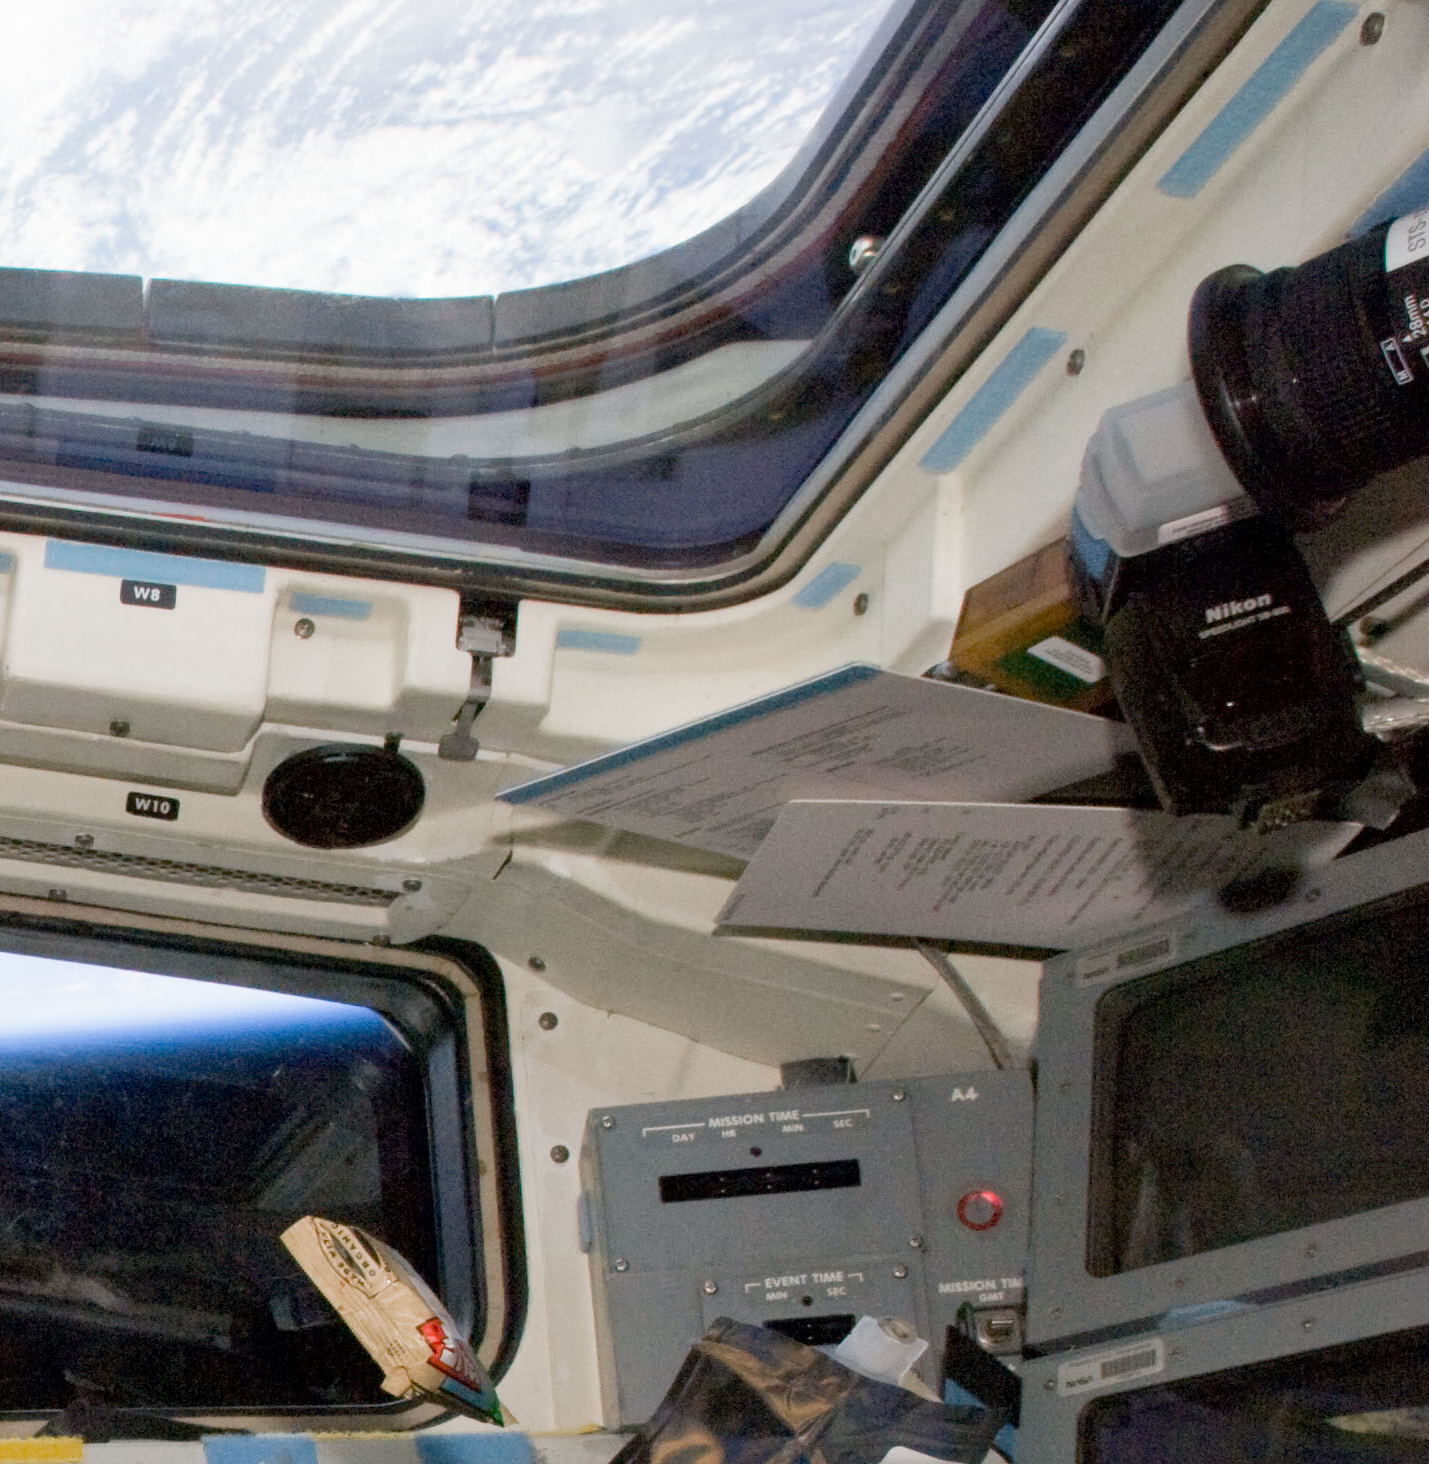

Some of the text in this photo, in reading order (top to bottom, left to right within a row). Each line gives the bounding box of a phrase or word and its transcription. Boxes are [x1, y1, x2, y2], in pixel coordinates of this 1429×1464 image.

[1405, 294, 1427, 339] 28mm
[133, 585, 160, 602] W8
[1205, 593, 1272, 624] Nikon
[134, 796, 171, 817] W10
[952, 1088, 978, 1102] A4
[708, 1110, 801, 1128] MISSION TIME
[833, 1118, 853, 1128] SEC
[782, 1123, 805, 1133] MIN
[672, 1132, 695, 1143] DAY
[330, 1222, 377, 1278] ORGANIC
[765, 1272, 845, 1288] EVENT TIME
[938, 1278, 1023, 1294] MISSION TIM
[766, 1291, 788, 1302] MIN
[827, 1287, 846, 1297] SEC
[978, 1293, 1005, 1303] GMT
